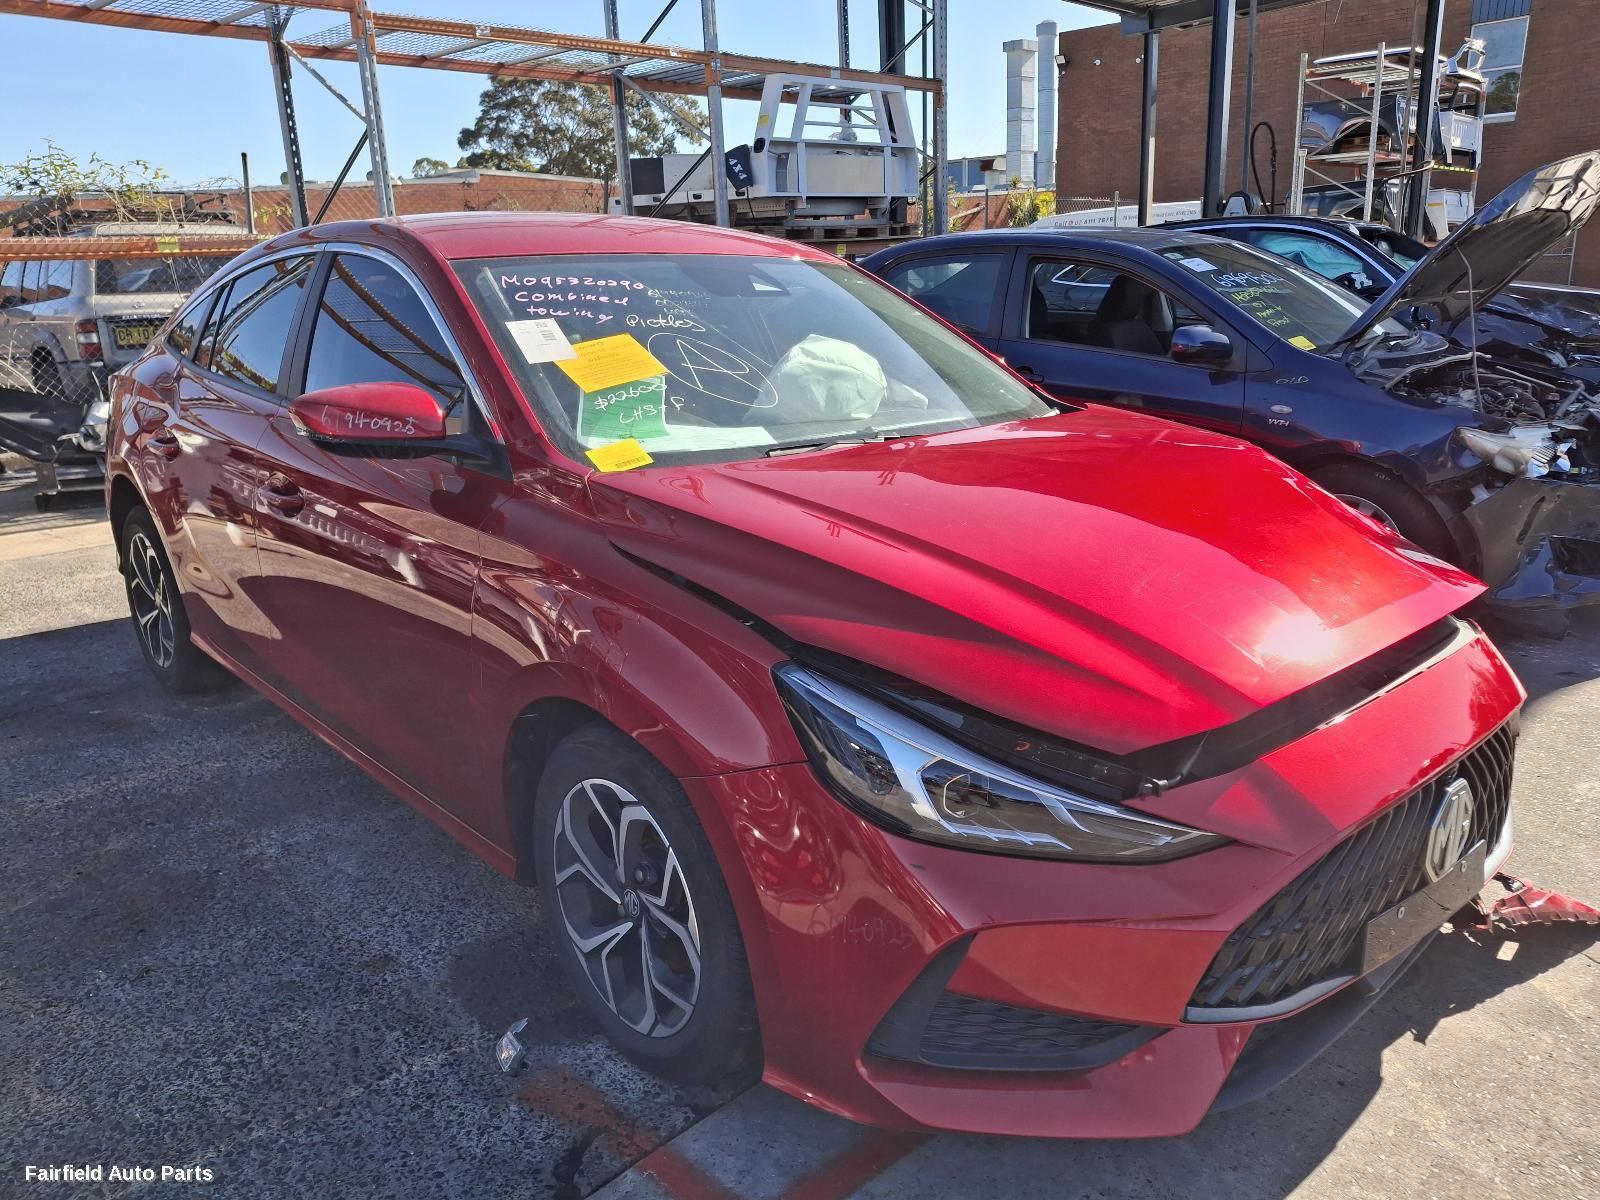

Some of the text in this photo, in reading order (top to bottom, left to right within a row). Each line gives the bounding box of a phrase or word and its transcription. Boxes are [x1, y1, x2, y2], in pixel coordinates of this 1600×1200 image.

[514, 290, 630, 306] Combined
[526, 306, 614, 324] towing
[1429, 785, 1473, 878] MG
[624, 889, 640, 917] MG
